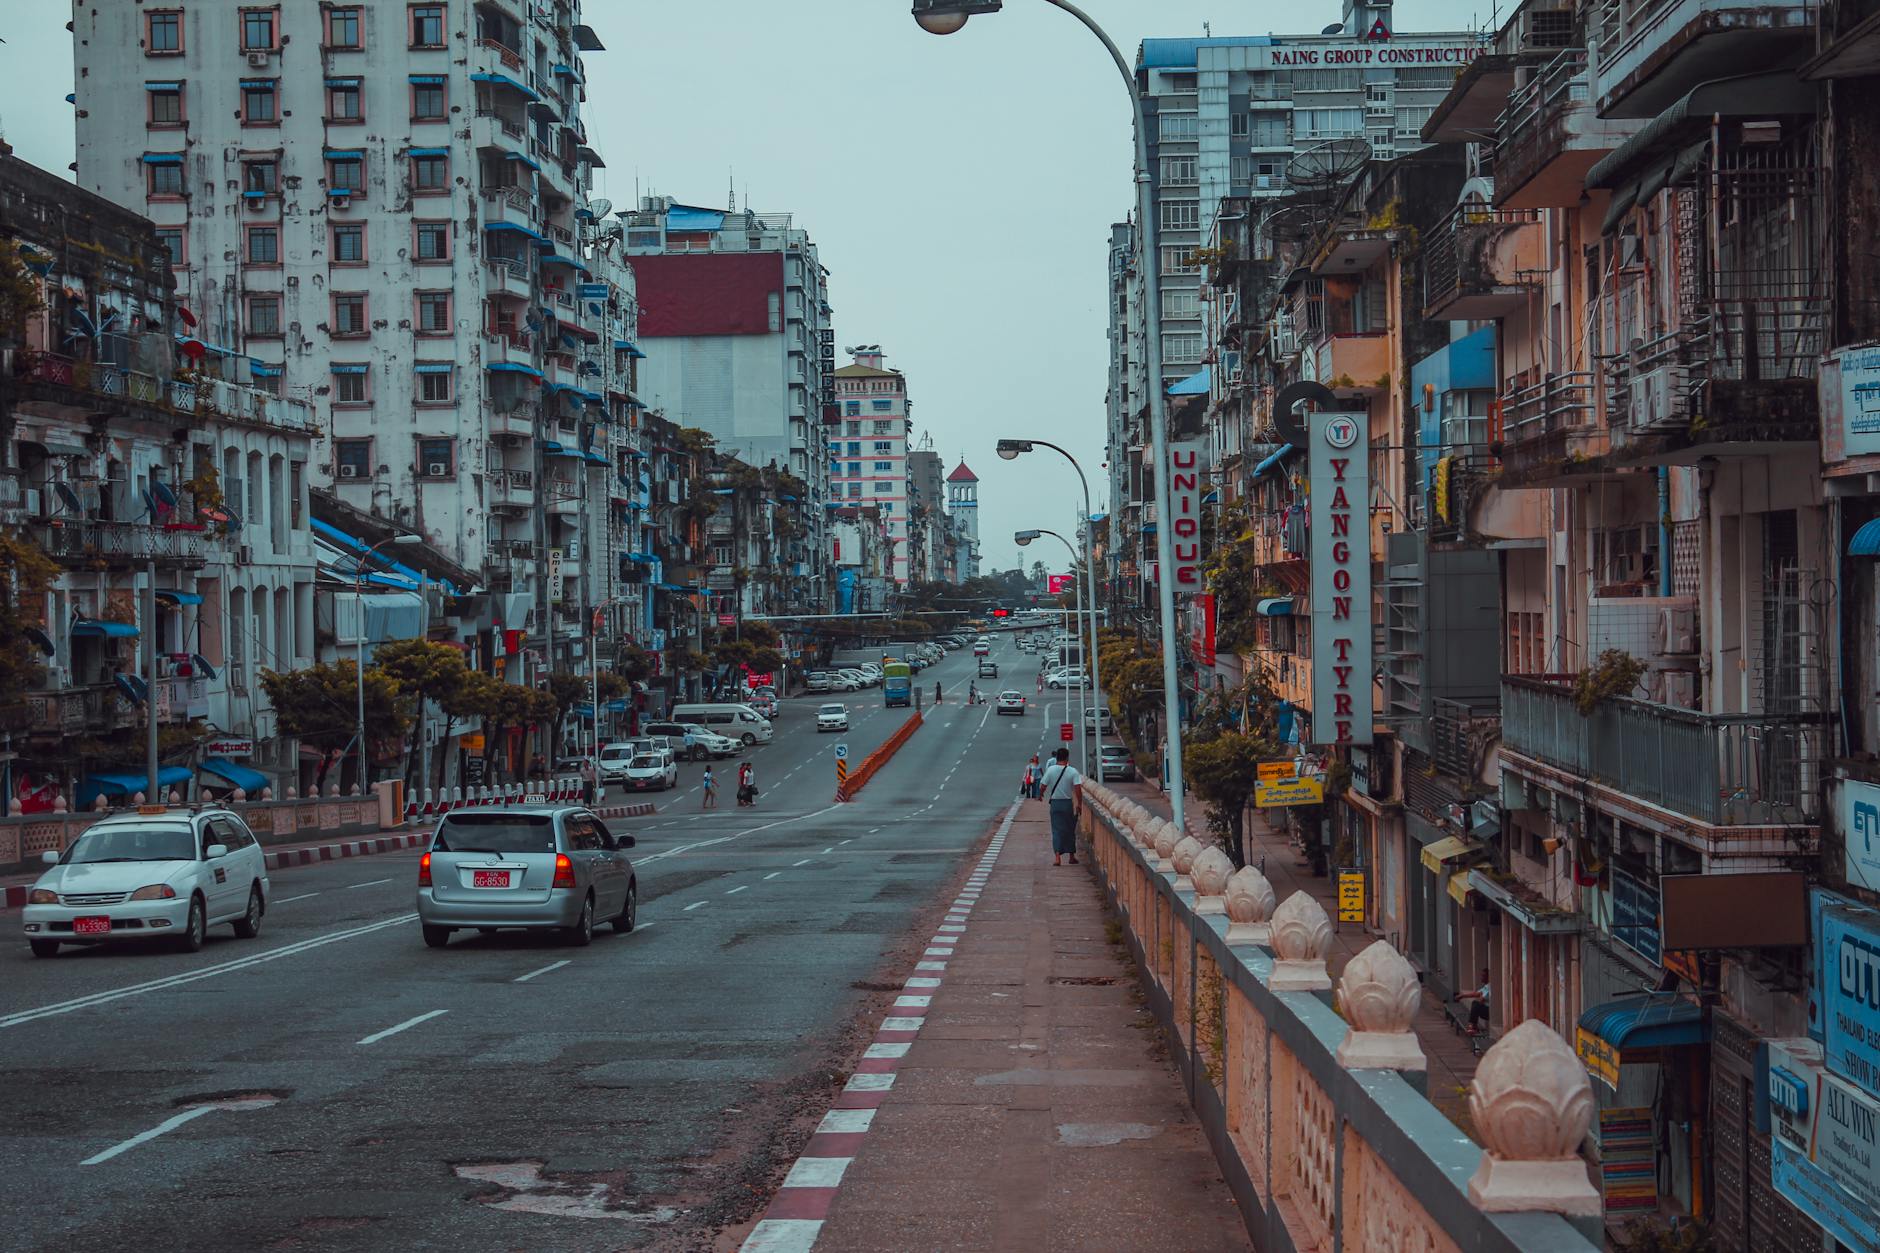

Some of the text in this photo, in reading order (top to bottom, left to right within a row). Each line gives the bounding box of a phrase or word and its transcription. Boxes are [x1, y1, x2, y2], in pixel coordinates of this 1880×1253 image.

[1271, 50, 1318, 65] NAING
[1324, 49, 1373, 64] GROUP
[822, 331, 833, 402] HOTEL
[1333, 425, 1350, 440] YT
[1173, 450, 1197, 584] UNIQUE
[551, 551, 561, 596] emtech
[1329, 458, 1353, 744] YANGON TYRE
[474, 876, 508, 887] GG-8530
[1836, 1012, 1865, 1043] THAILAND
[1845, 1049, 1871, 1082] SHOW
[1770, 1071, 1798, 1113] OTTO
[1827, 1086, 1850, 1129] ALL
[1851, 1098, 1876, 1146] WIN
